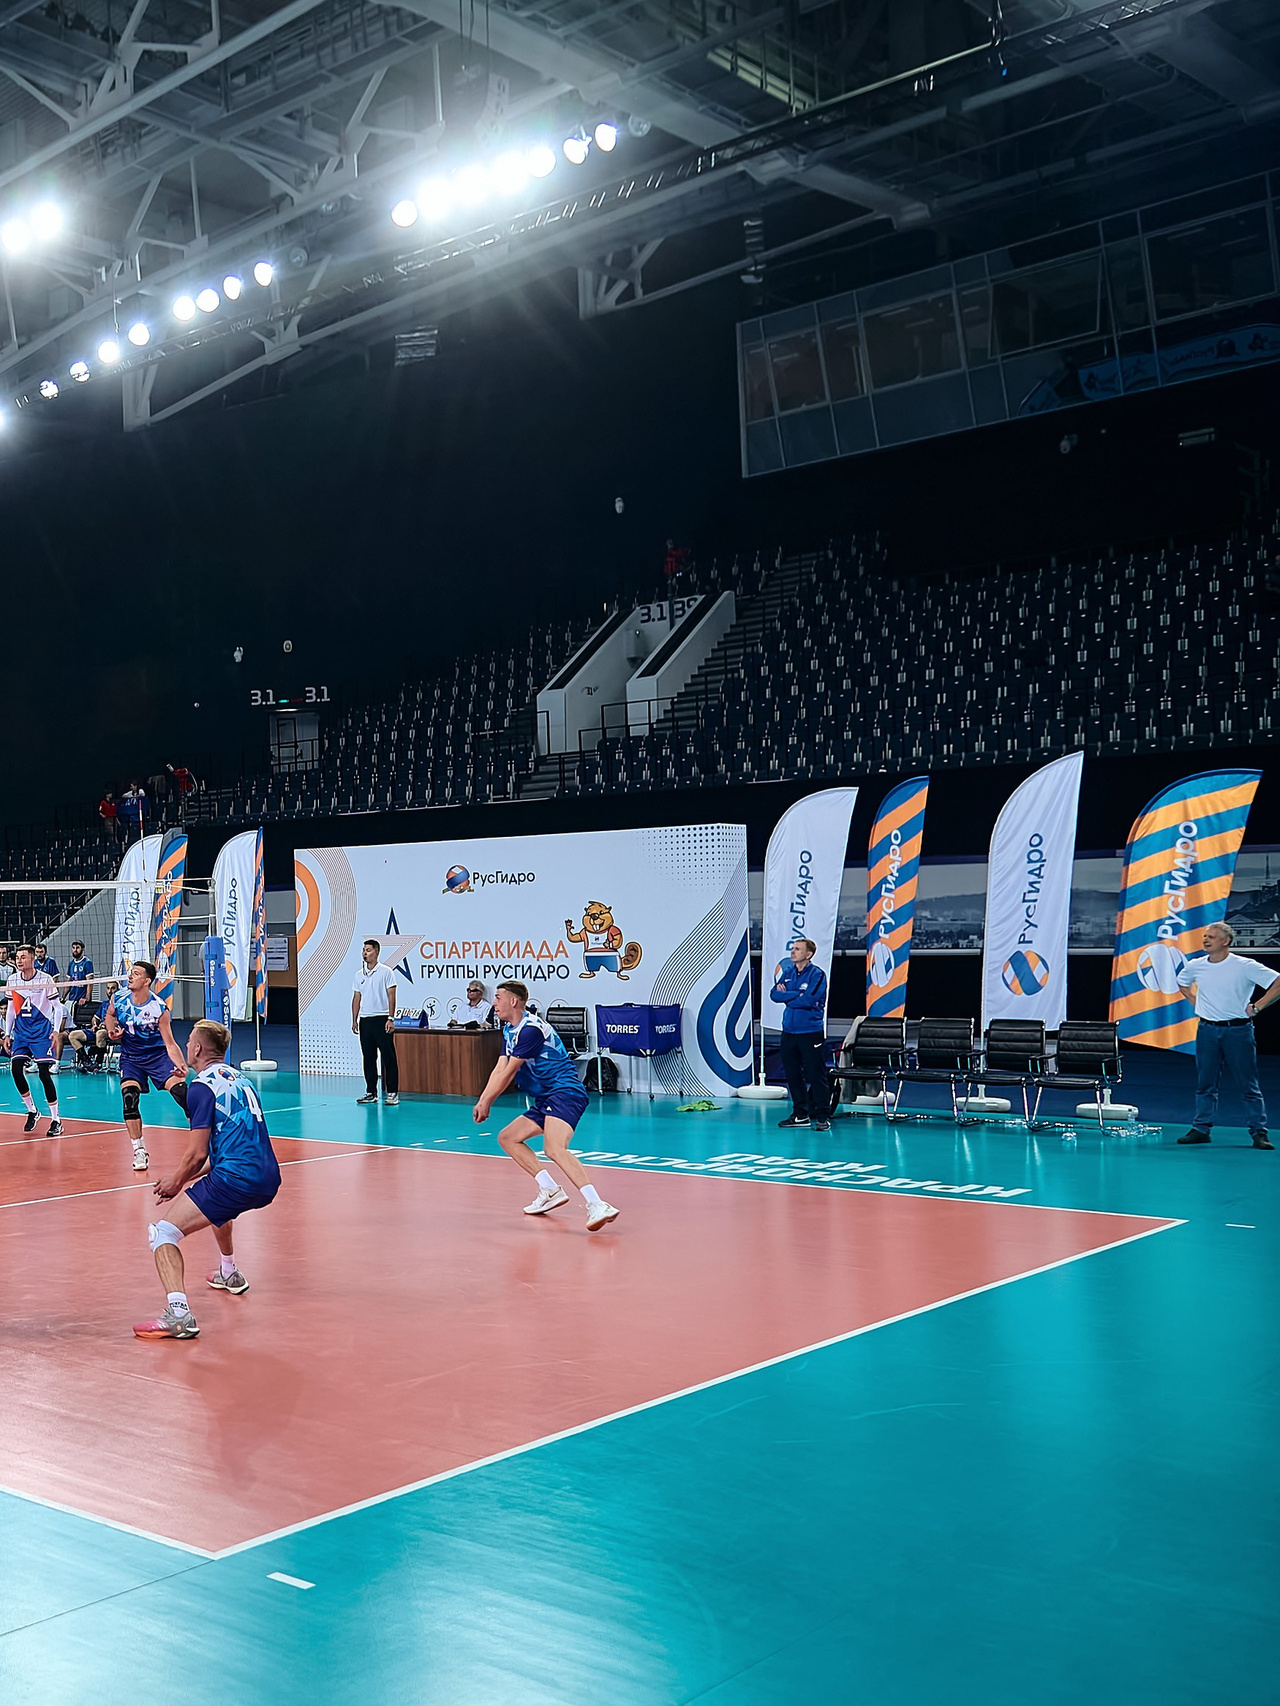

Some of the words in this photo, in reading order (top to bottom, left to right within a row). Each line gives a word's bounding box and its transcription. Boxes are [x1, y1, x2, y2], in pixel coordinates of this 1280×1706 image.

[638, 604, 667, 623] 3.1
[250, 689, 276, 706] 3.1
[305, 686, 331, 703] 3.1
[472, 870, 536, 887] РусГидро
[878, 829, 902, 939] РусГидро
[1157, 821, 1200, 941] РусГидро
[1018, 833, 1047, 945] РусГидро
[420, 940, 569, 961] СПАРТАКИАДА
[420, 964, 479, 980] ГРУППЫ
[483, 964, 570, 982] РУСГИДРО
[21, 996, 32, 1012] 4
[606, 1024, 640, 1034] TORRES
[655, 1024, 677, 1034] TORRES
[242, 1086, 262, 1122] 4
[707, 1152, 887, 1173] КРАЙ
